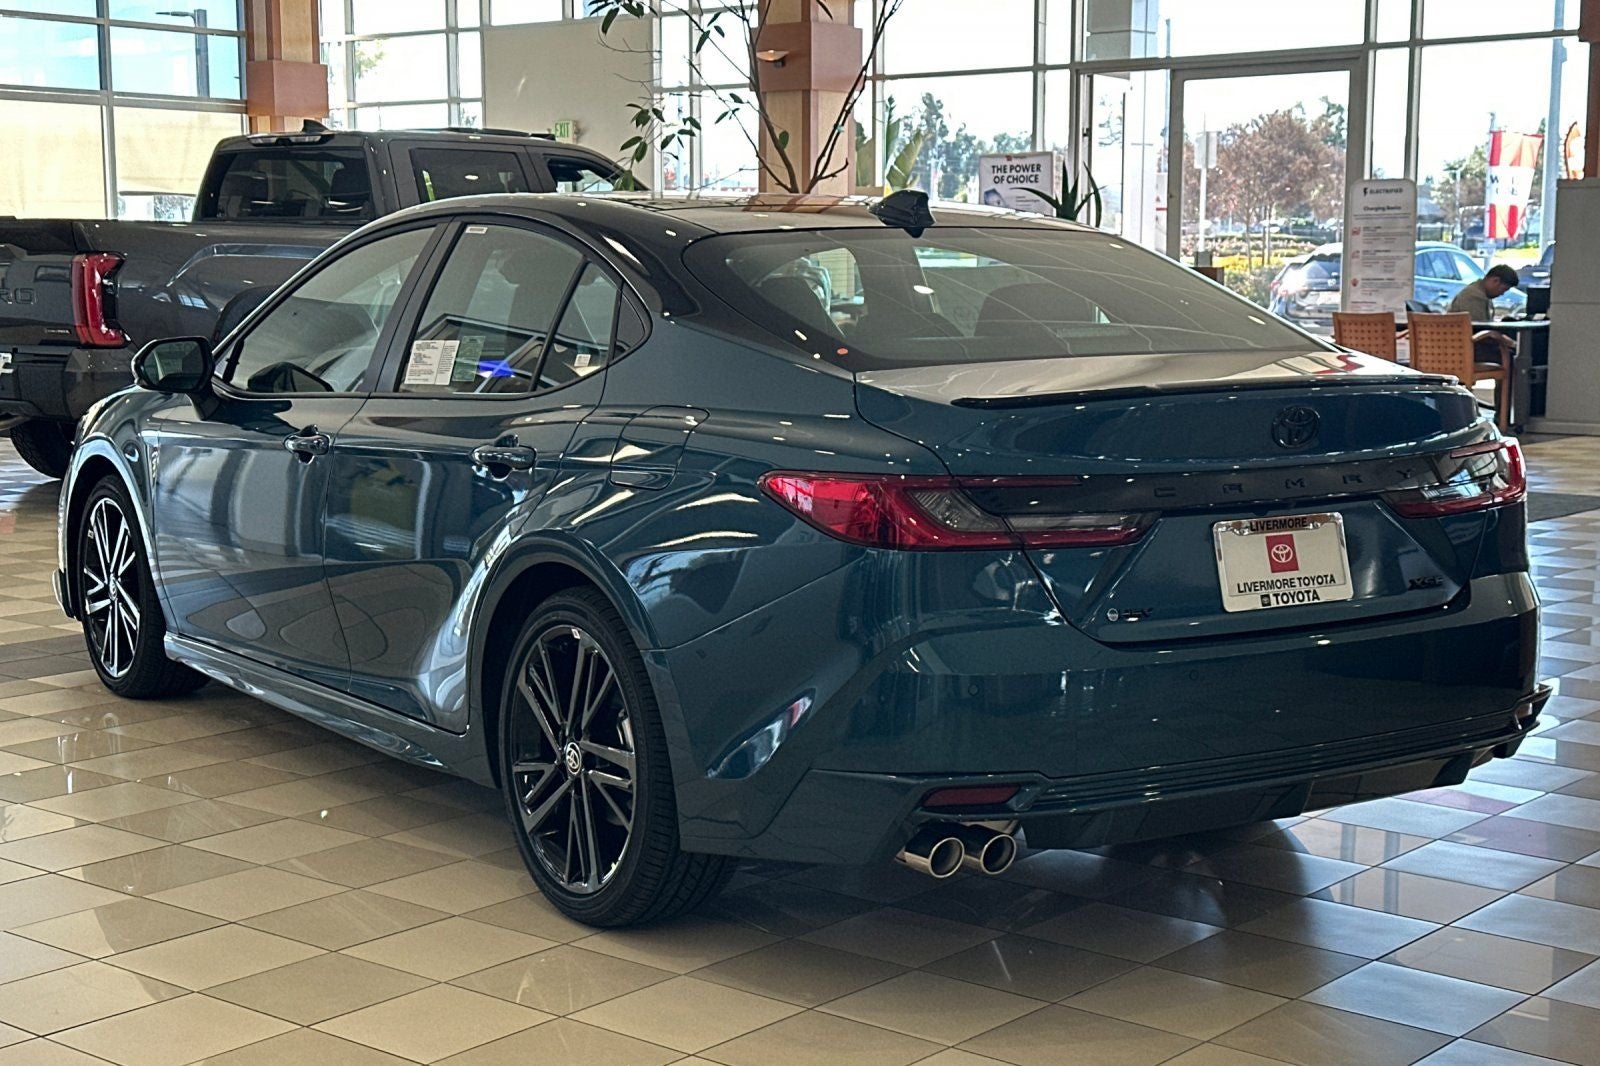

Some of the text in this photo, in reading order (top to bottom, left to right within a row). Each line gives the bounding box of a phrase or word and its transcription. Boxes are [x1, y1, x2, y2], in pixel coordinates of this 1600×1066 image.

[554, 122, 570, 138] EXIT
[991, 163, 1042, 174] THE POWER
[993, 174, 1039, 184] OF CHOICE
[1153, 468, 1414, 498] CAMRY
[1250, 517, 1308, 532] LIVERMORE
[1237, 574, 1336, 594] LIVERMORE TOYOTA
[1273, 589, 1320, 605] TOYOTA
